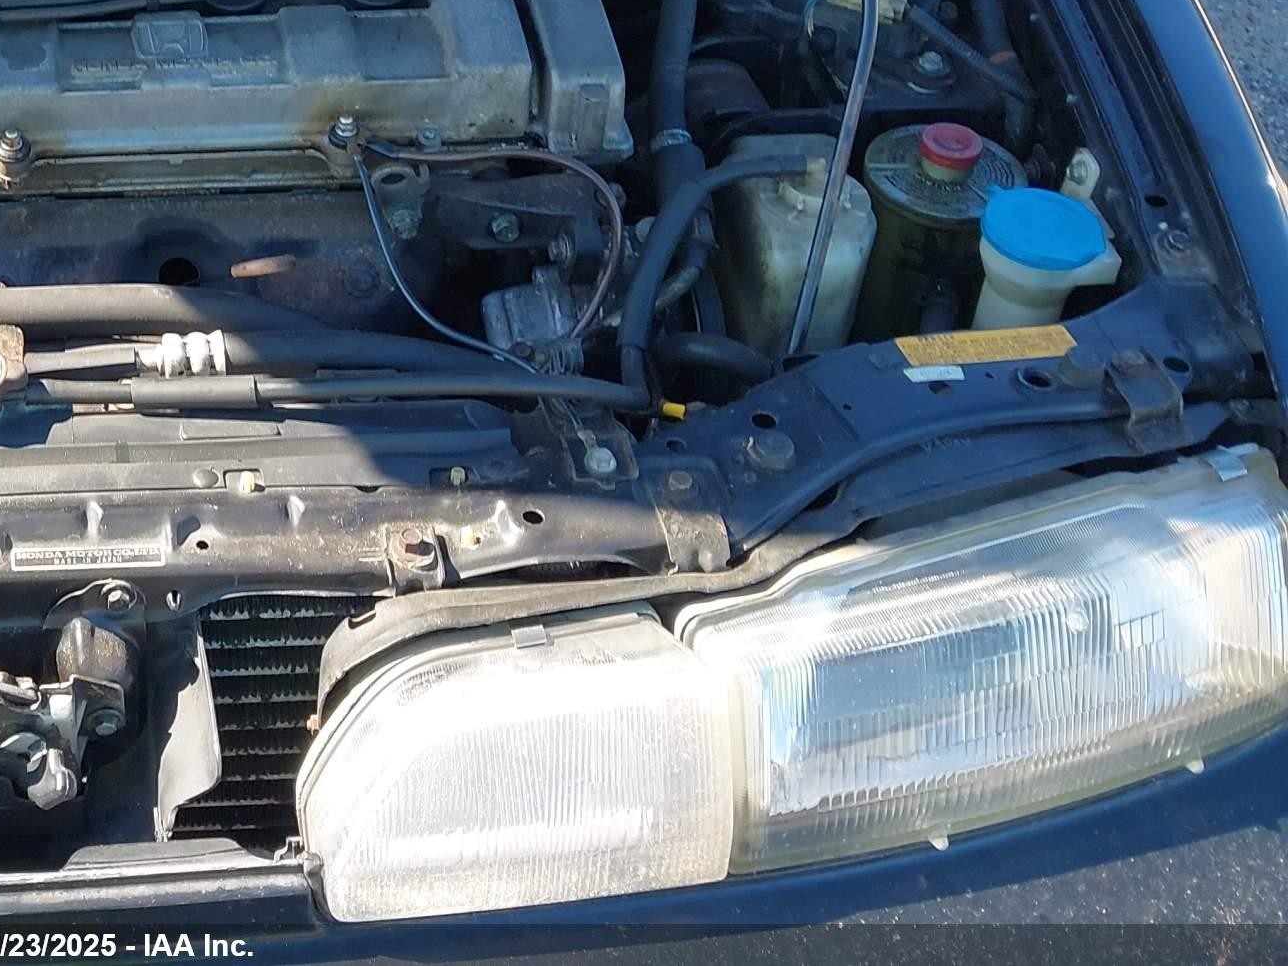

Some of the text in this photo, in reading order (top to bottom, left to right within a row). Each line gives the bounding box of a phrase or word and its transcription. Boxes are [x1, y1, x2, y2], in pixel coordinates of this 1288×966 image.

[15, 550, 63, 560] HONDA
[65, 549, 113, 558] MOTOR
[53, 557, 78, 566] MADE
[96, 555, 123, 564] JAPAN
